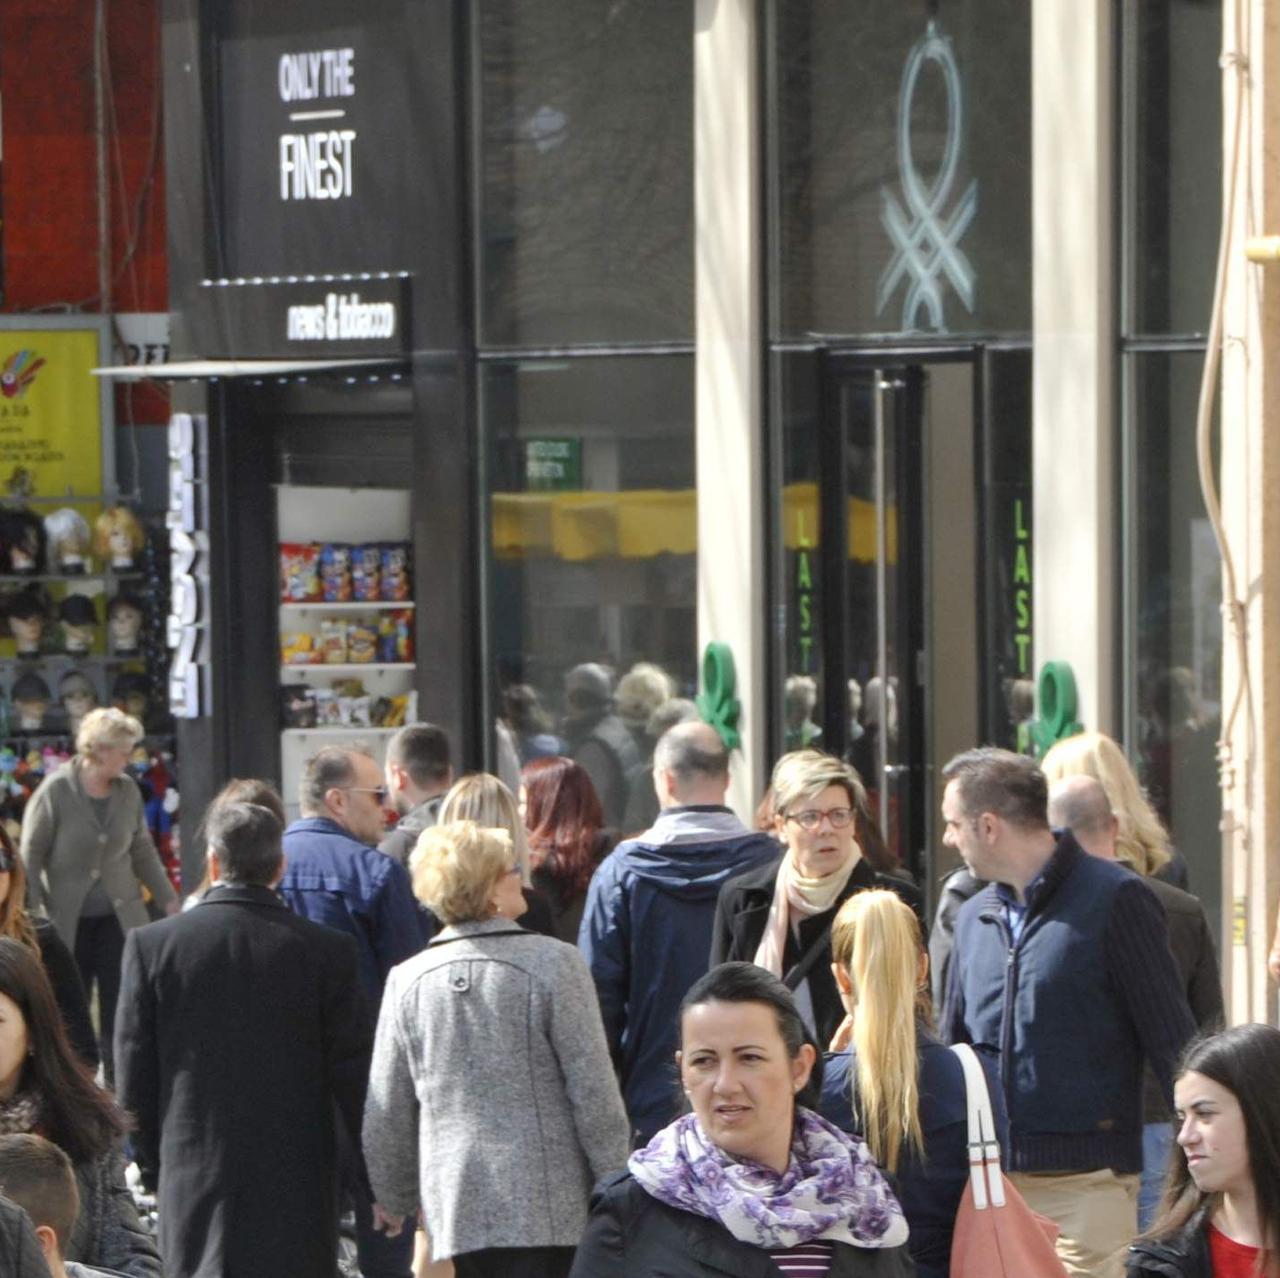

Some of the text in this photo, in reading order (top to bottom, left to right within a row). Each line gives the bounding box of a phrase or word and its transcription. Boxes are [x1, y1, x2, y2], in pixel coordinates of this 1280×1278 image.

[278, 47, 355, 102] ONLY THE
[279, 129, 357, 200] FINEST
[797, 508, 812, 674] LAST
[1014, 499, 1031, 674] LAST
